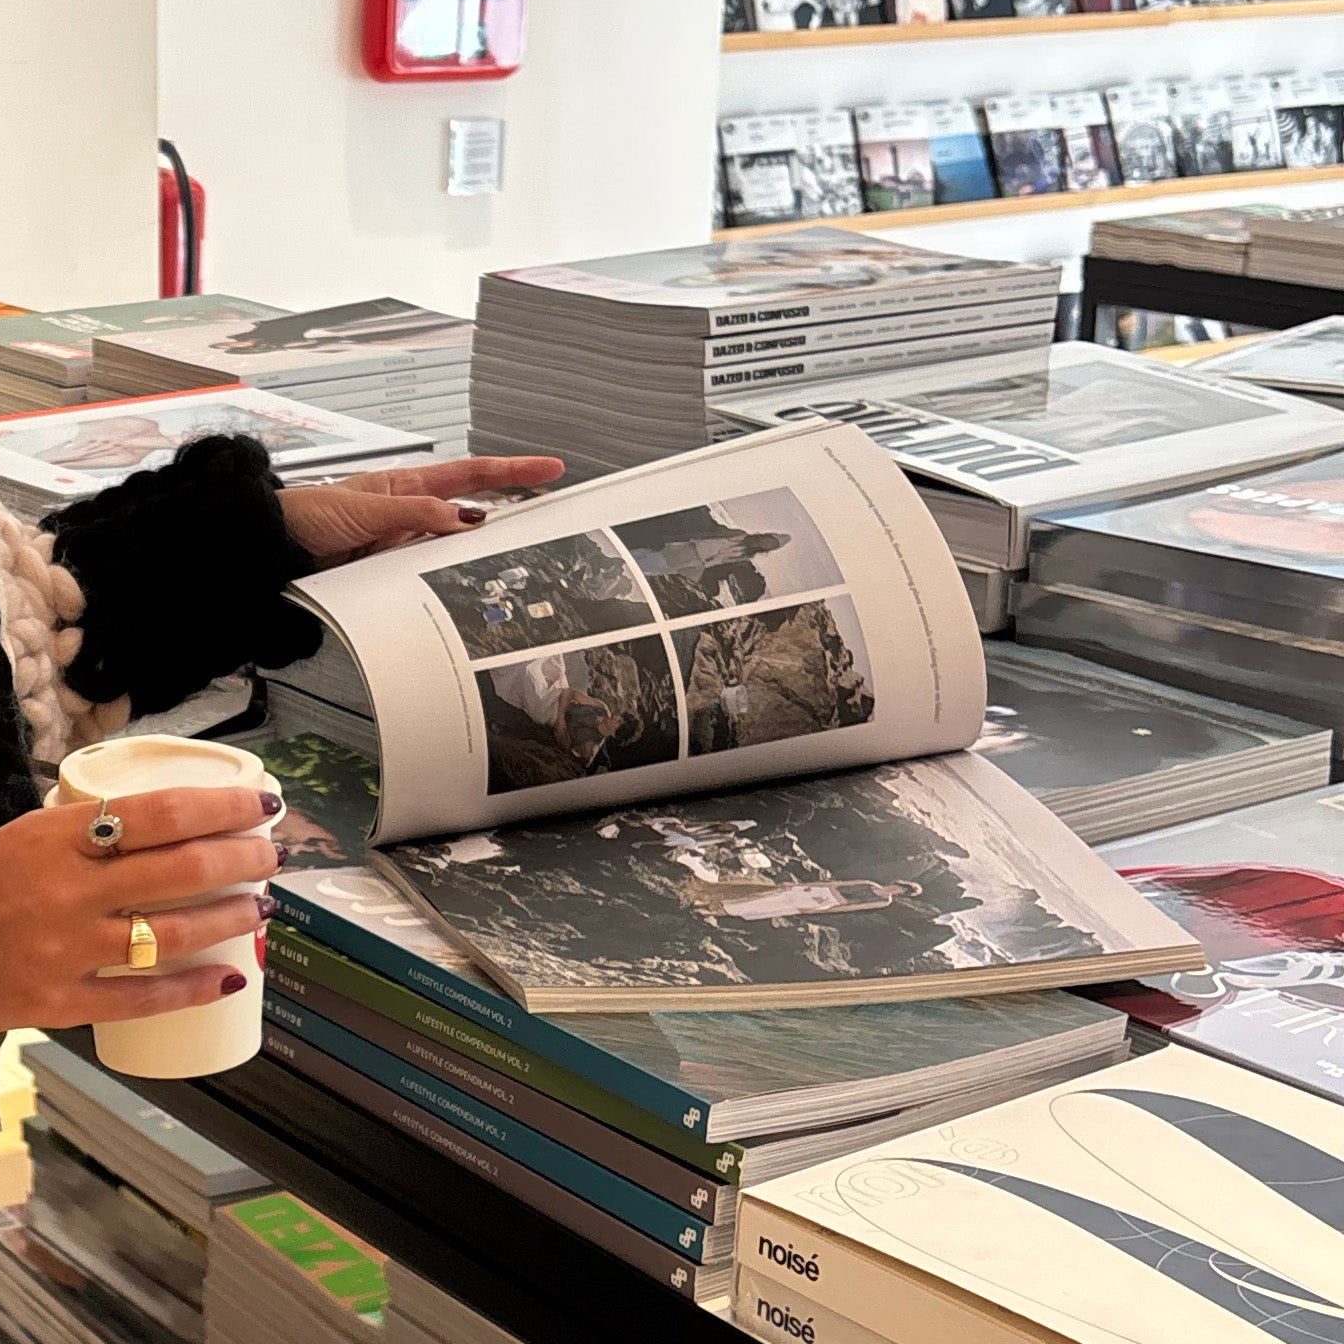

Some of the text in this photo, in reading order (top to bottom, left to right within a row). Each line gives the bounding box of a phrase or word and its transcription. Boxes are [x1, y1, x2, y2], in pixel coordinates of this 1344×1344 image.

[279, 946, 309, 967] GUIDE
[422, 1013, 455, 1040] LIFESTYLE
[455, 1029, 506, 1064] COMPENDIUM
[283, 903, 311, 925] GUIDE
[413, 969, 444, 994] LIFESTYLE
[444, 984, 491, 1019] COMPENDIUM
[276, 971, 306, 995] GUIDE
[413, 1044, 444, 1069] LIFESTYLE
[444, 1058, 493, 1095] COMPENDIUM
[406, 1079, 437, 1103] LIFESTYLE
[758, 1233, 820, 1282] noisé
